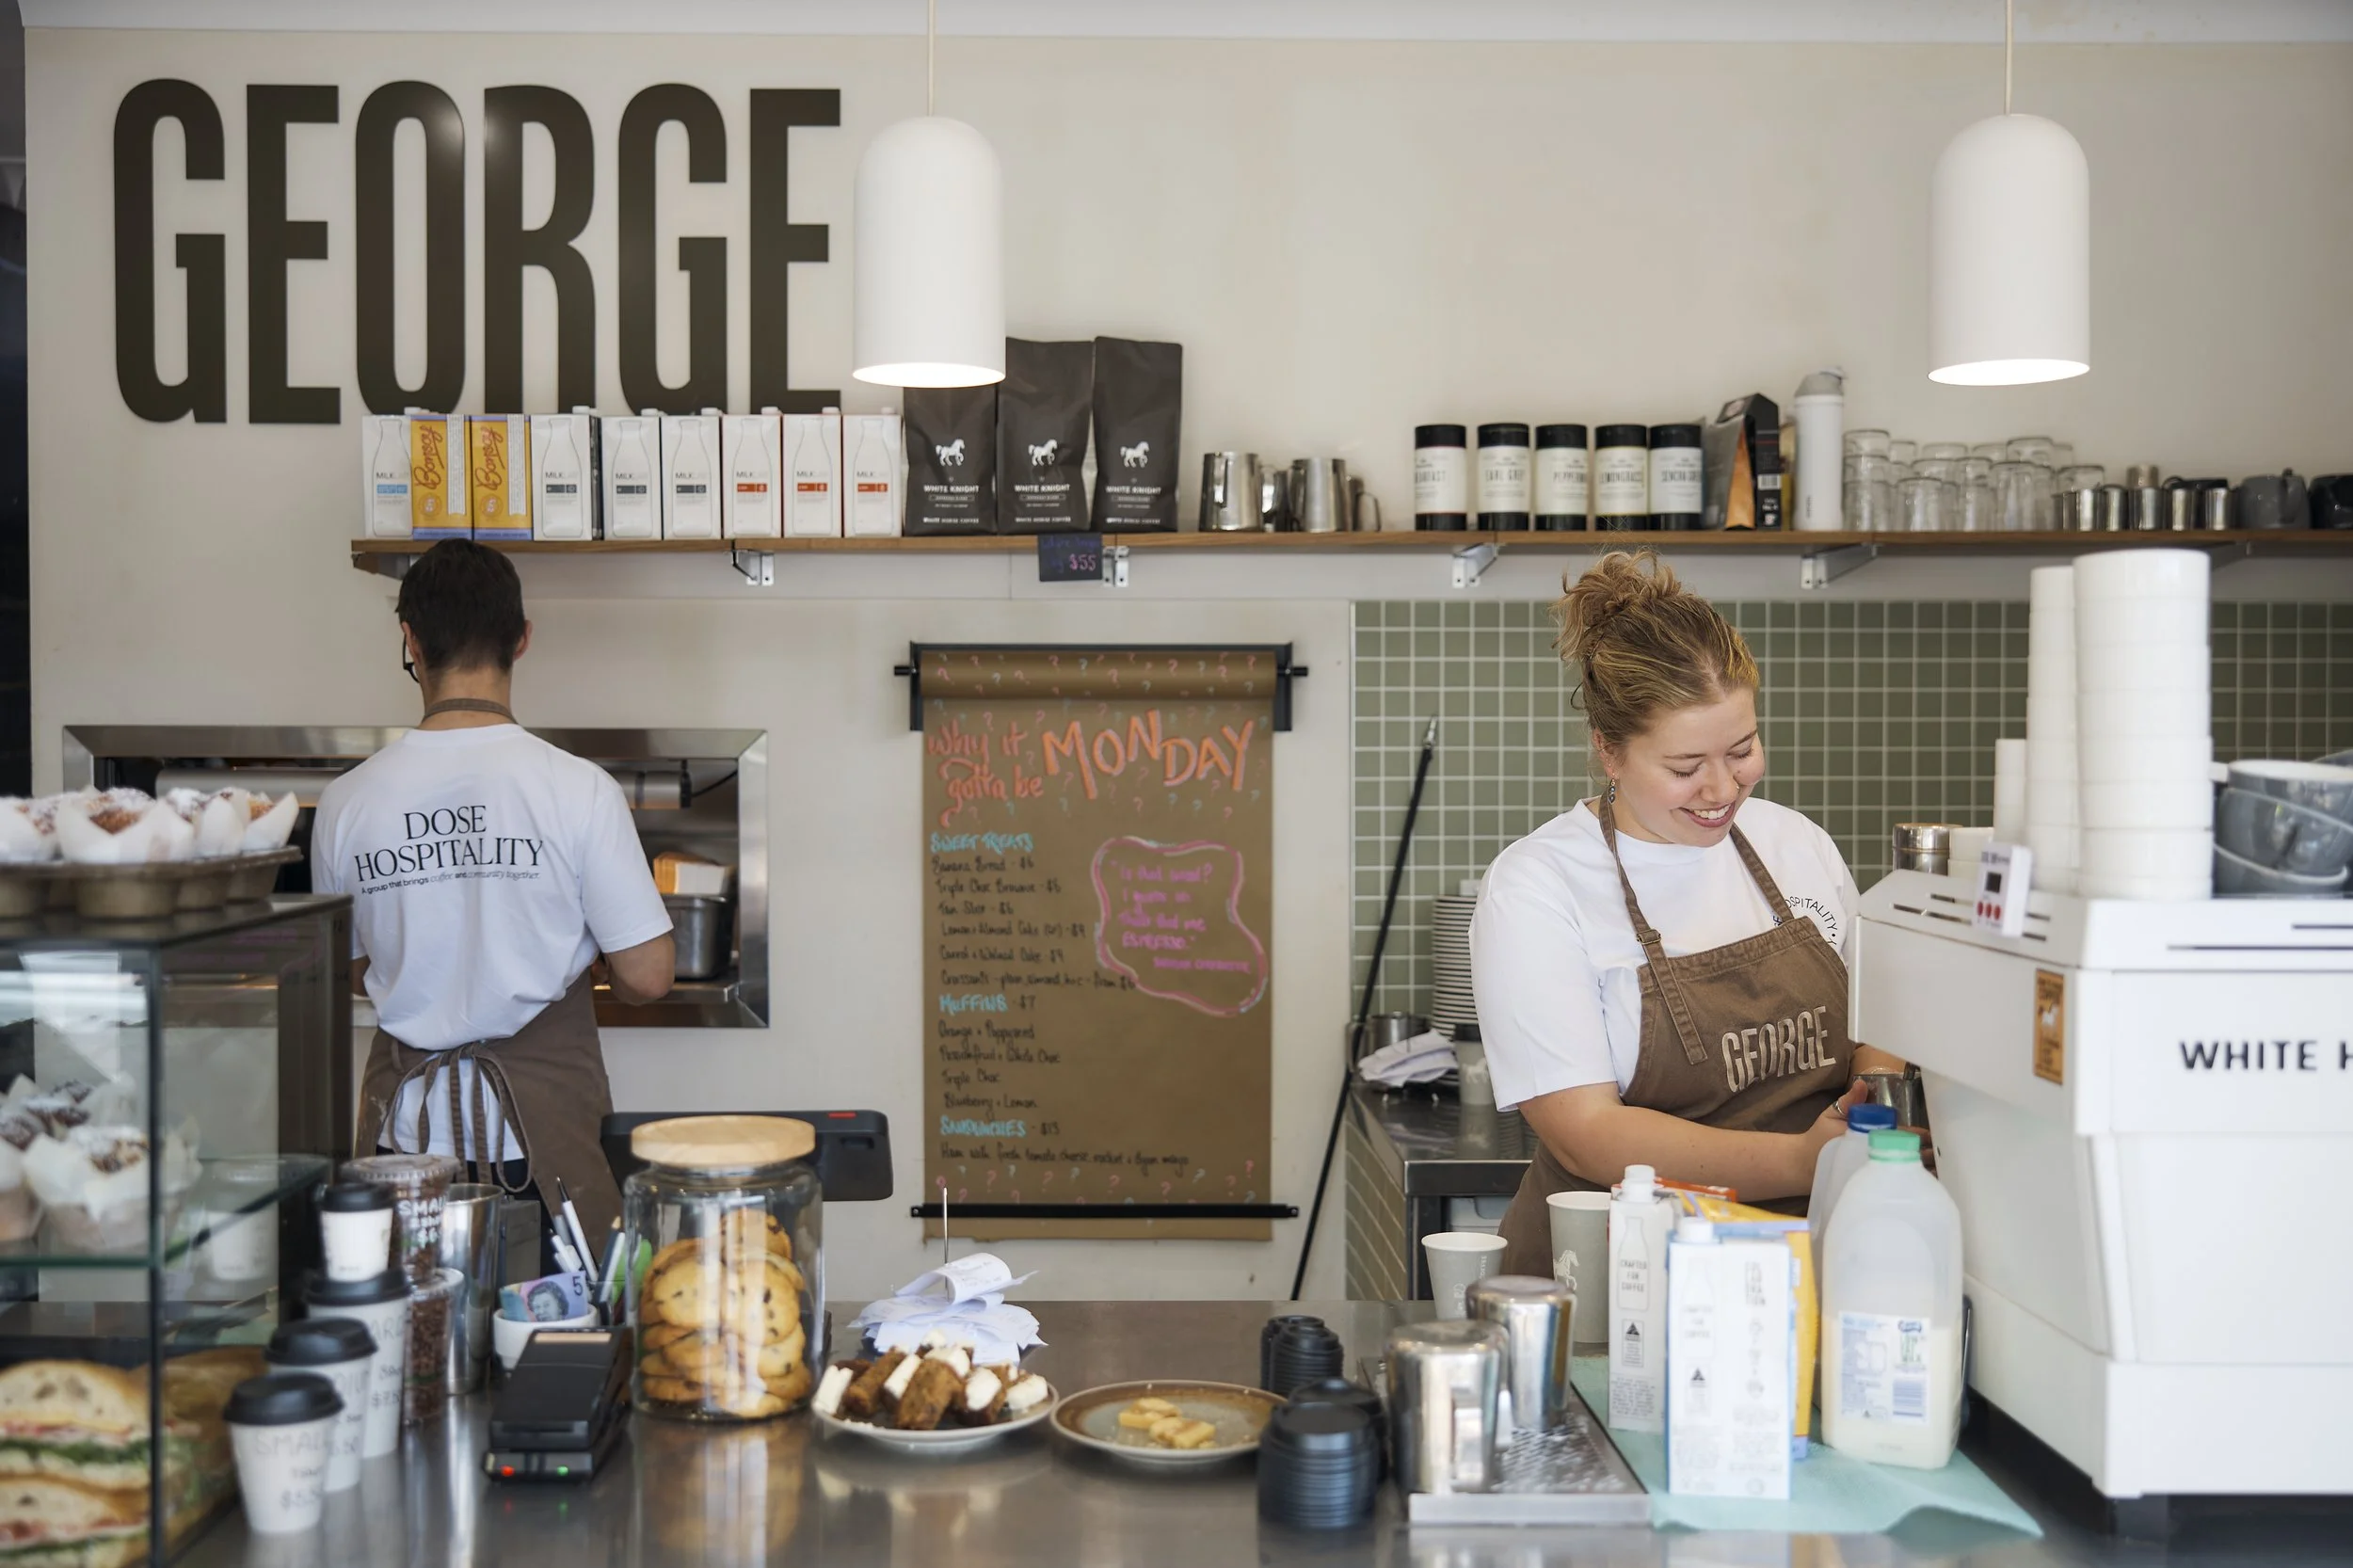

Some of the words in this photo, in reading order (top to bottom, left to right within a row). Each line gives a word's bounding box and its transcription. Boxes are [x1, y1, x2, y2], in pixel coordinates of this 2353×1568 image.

[113, 78, 841, 424] GEORGE
[922, 485, 949, 493] WHITE
[950, 485, 980, 493] KNIGHT
[1014, 484, 1040, 493] WHITE
[1041, 483, 1071, 493] KNIGHT
[1106, 486, 1130, 494] WHITE
[1131, 486, 1162, 494] KNIGHT
[1041, 709, 1255, 800] MONDAY
[1015, 764, 1044, 799] be
[403, 805, 488, 840] DOSE
[354, 837, 544, 883] HOSPITALITY
[367, 883, 389, 894] group
[389, 877, 403, 888] that
[403, 876, 429, 888] brings
[1784, 895, 1838, 932] OSPITALITY
[1721, 1005, 1837, 1094] GEORGE
[2179, 1040, 2318, 1071] WHITE
[571, 1275, 584, 1297] 5
